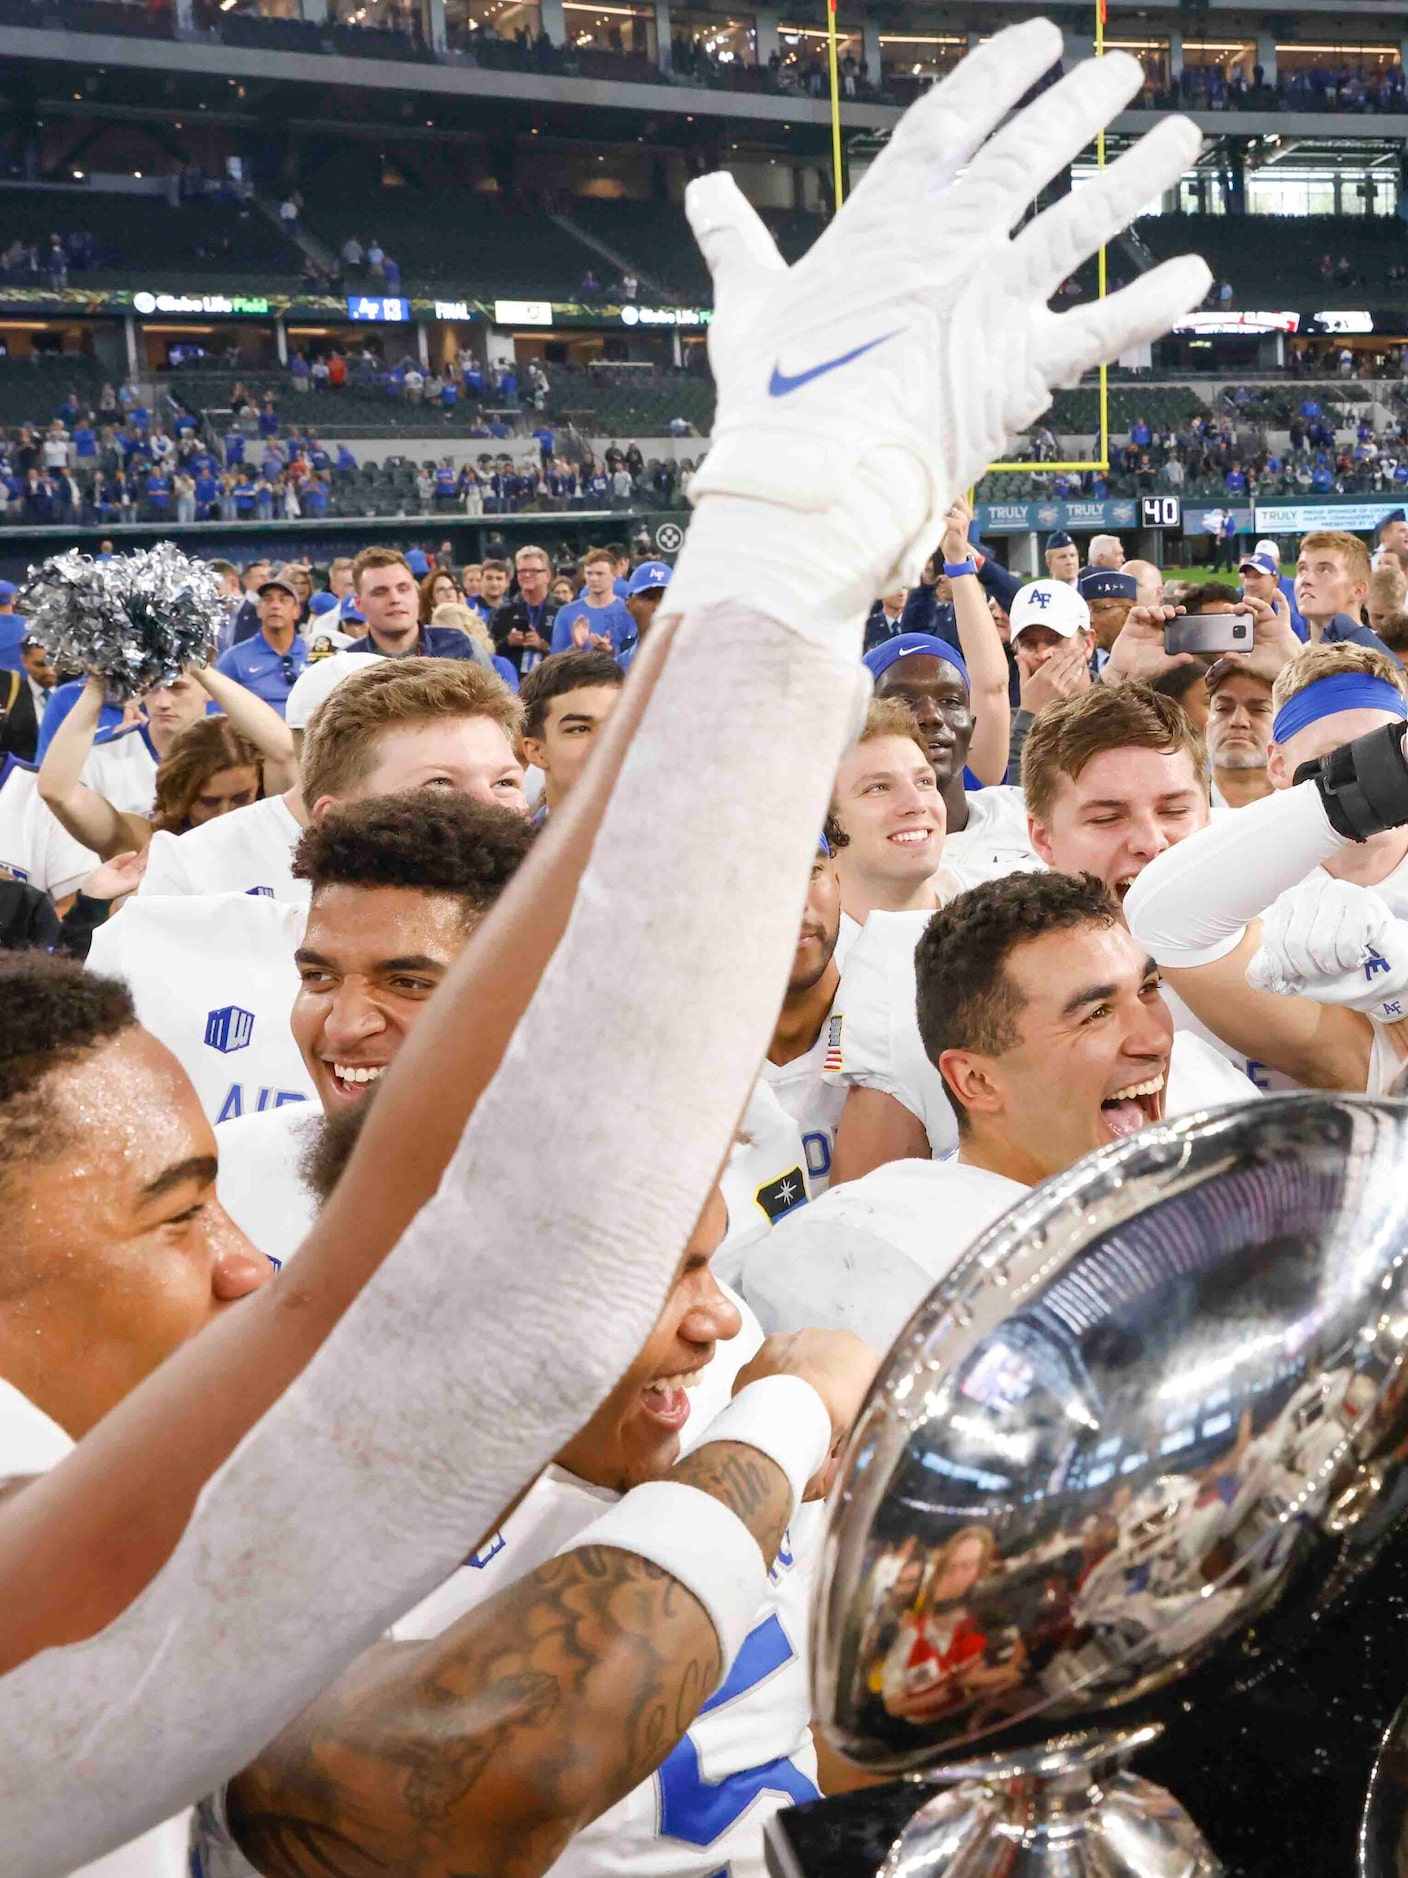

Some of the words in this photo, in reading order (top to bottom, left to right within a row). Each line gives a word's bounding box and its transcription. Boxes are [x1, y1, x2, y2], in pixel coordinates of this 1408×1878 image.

[155, 296, 203, 312] Globe
[203, 297, 233, 314] Life
[233, 298, 268, 313] Field
[435, 301, 471, 321] FINAL
[639, 309, 676, 324] Globe
[676, 310, 699, 325] Life
[988, 506, 1029, 519] TRULY
[1066, 503, 1105, 517] TRULY
[1143, 497, 1178, 525] 40
[1261, 511, 1298, 521] TRULY
[1028, 589, 1052, 609] AF
[1382, 1000, 1402, 1015] AF
